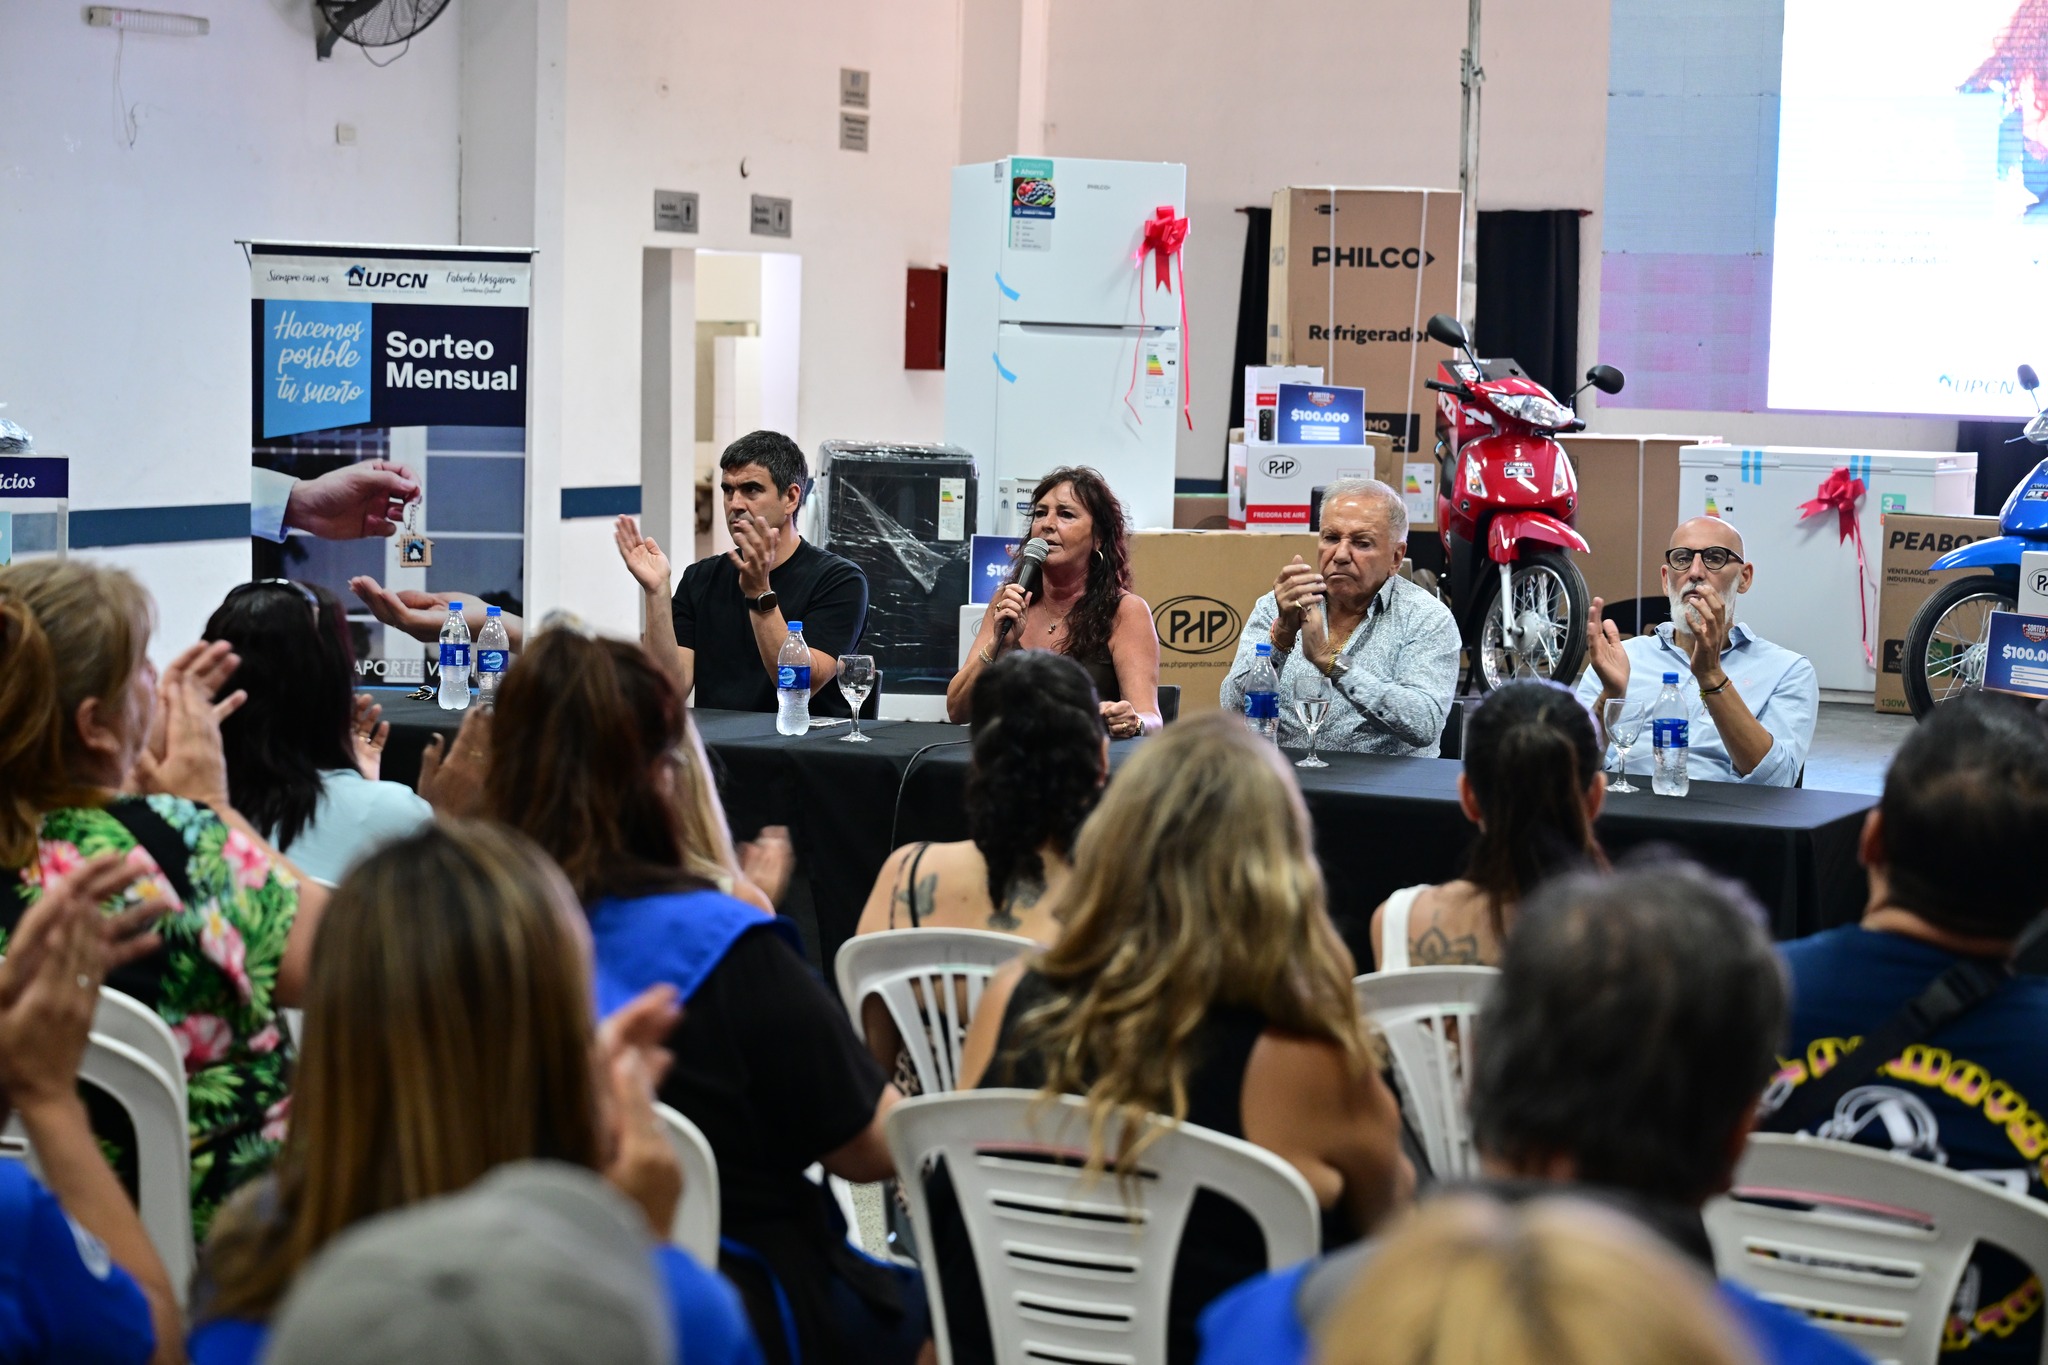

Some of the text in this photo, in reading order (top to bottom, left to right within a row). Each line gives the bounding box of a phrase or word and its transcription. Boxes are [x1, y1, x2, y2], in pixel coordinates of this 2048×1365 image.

[1311, 246, 1424, 269] PHILCO
[365, 271, 429, 289] UPCN
[273, 310, 364, 342] Hacemos
[386, 331, 494, 360] Sorteo
[277, 340, 361, 374] posible
[386, 362, 518, 391] Mensual
[274, 374, 364, 404] tu sueño
[1955, 379, 2015, 395] UPCN
[1290, 408, 1350, 424] $100.000
[1268, 461, 1295, 474] PHP
[1883, 496, 1894, 511] 3
[1253, 511, 1282, 519] FREIDORA
[1889, 530, 1992, 552] PEABO
[1886, 576, 1927, 585] INDUSTRIAL
[1887, 567, 1930, 576] VENTILADOR
[1169, 610, 1228, 643] PHP
[2002, 643, 2048, 663] $100.0
[354, 659, 422, 676] APORTE
[1881, 698, 1906, 708] 130W
